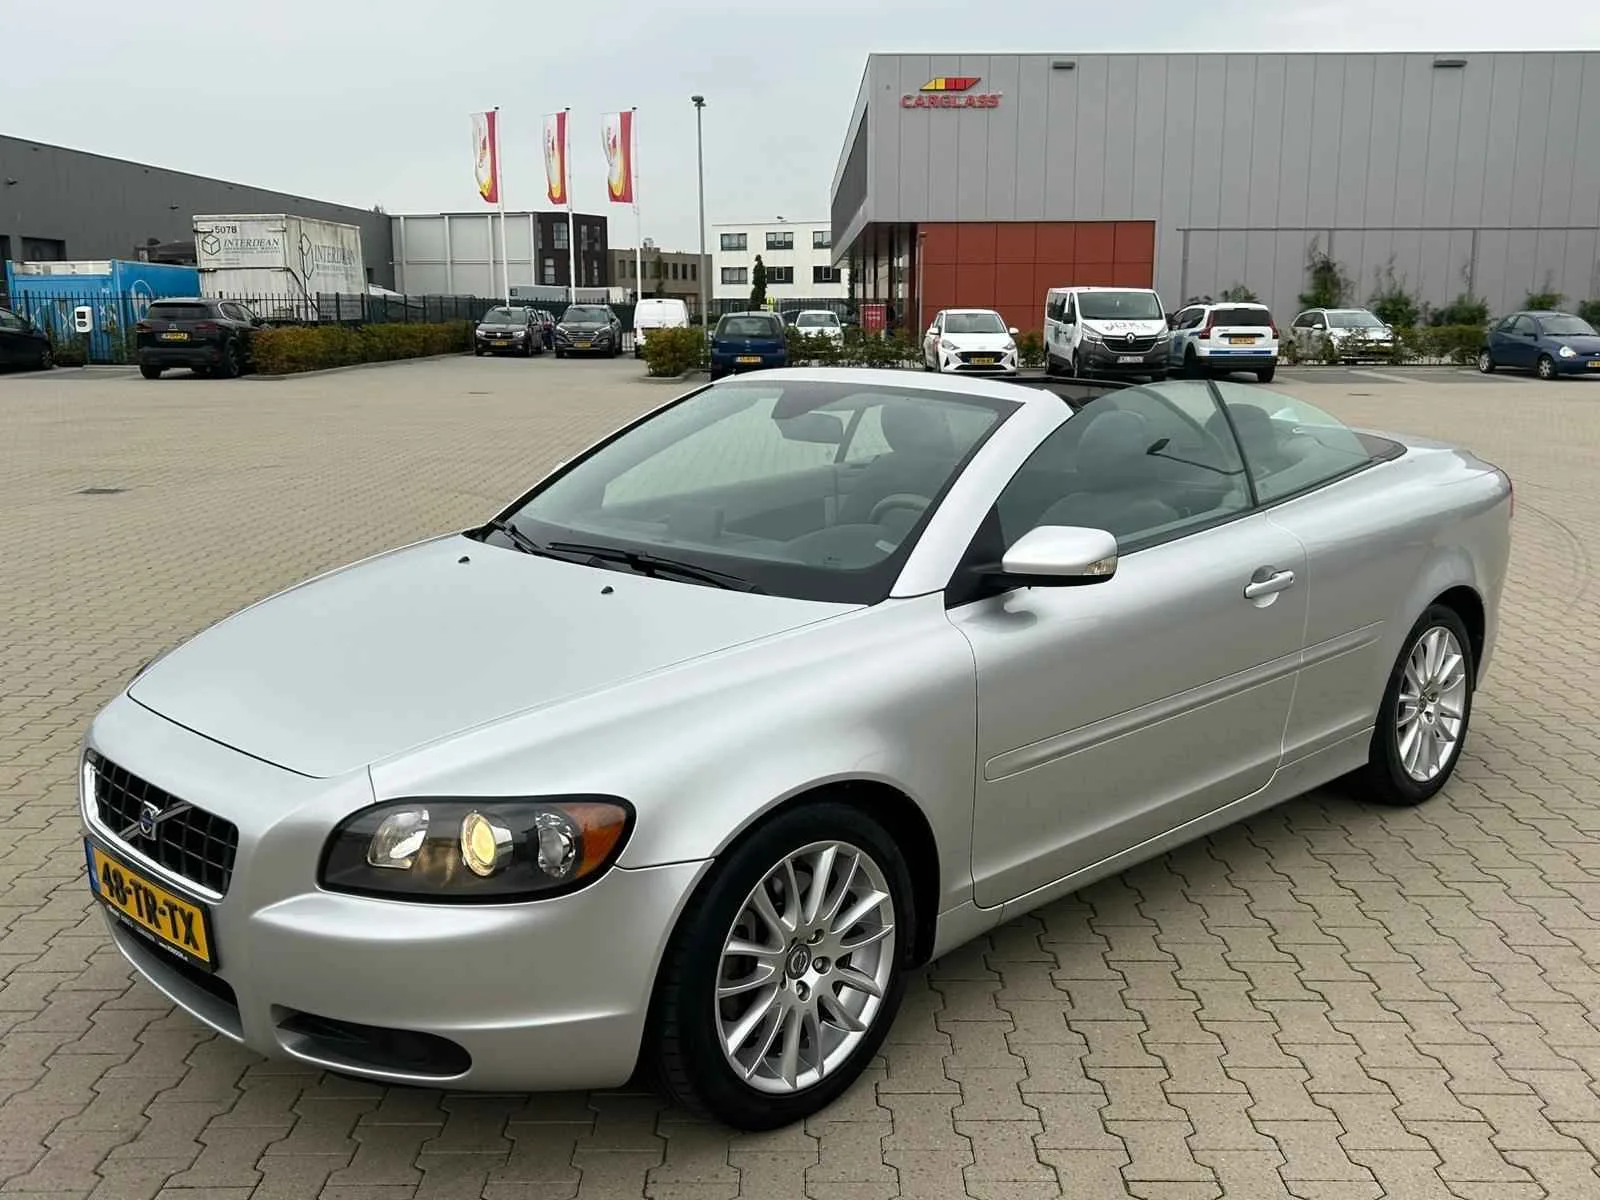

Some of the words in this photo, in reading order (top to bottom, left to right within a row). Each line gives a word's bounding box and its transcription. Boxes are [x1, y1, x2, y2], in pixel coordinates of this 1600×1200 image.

[902, 94, 1000, 108] CARGLASS
[223, 238, 280, 248] INTERDEAN
[102, 862, 200, 951] 48-TR-TX
